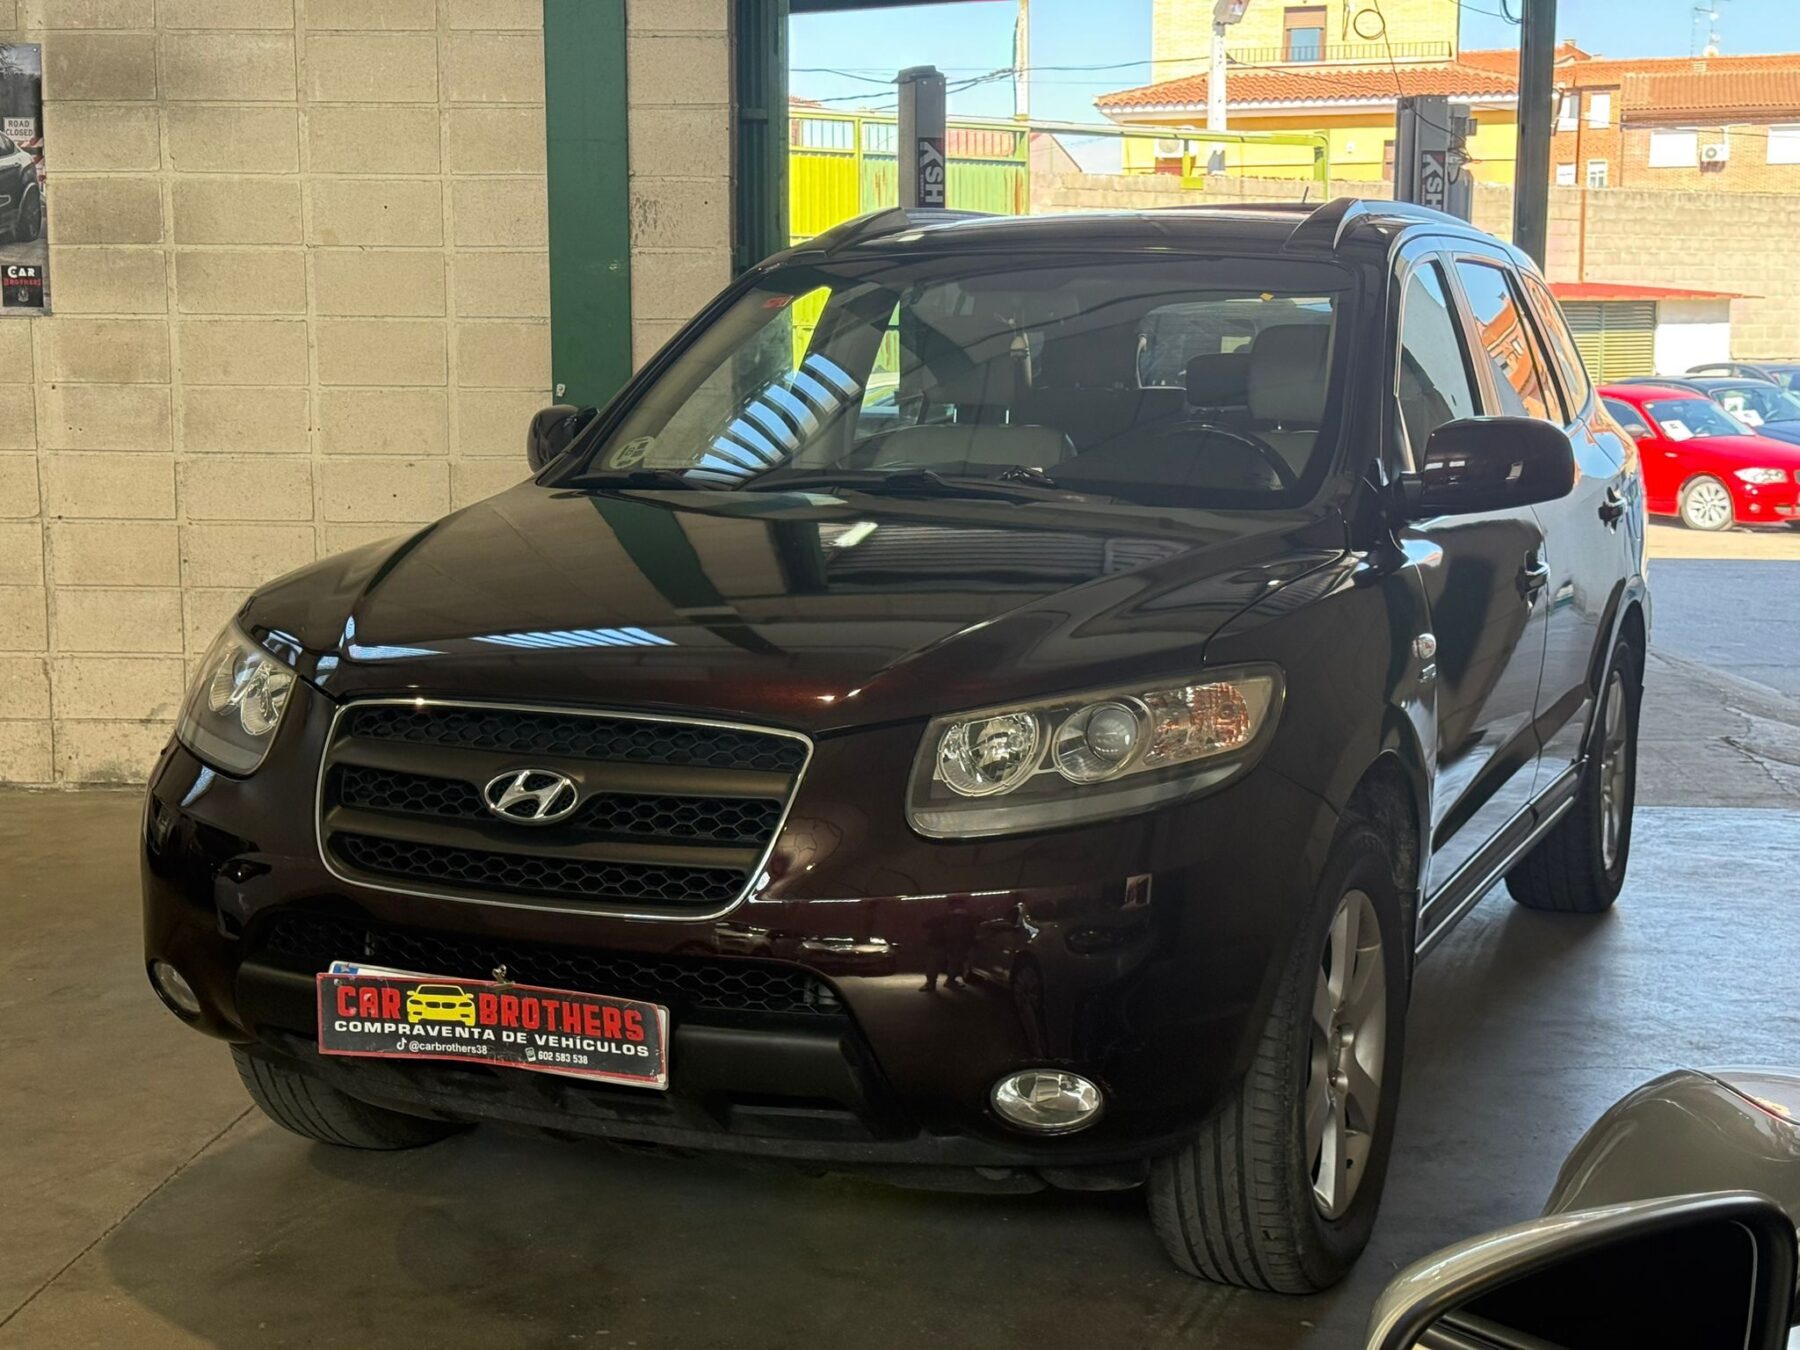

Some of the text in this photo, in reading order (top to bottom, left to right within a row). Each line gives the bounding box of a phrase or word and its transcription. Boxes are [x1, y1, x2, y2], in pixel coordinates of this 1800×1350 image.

[8, 120, 30, 128] ROAD
[5, 128, 34, 137] CLOSED
[7, 265, 36, 278] CAR
[336, 985, 645, 1042] CAR BROTHERS
[334, 1020, 650, 1057] COMPRAVENTA DE VEHÍCULOS
[408, 1040, 488, 1055] @carbrothers38
[538, 1050, 554, 1061] 602
[573, 1054, 589, 1065] 538
